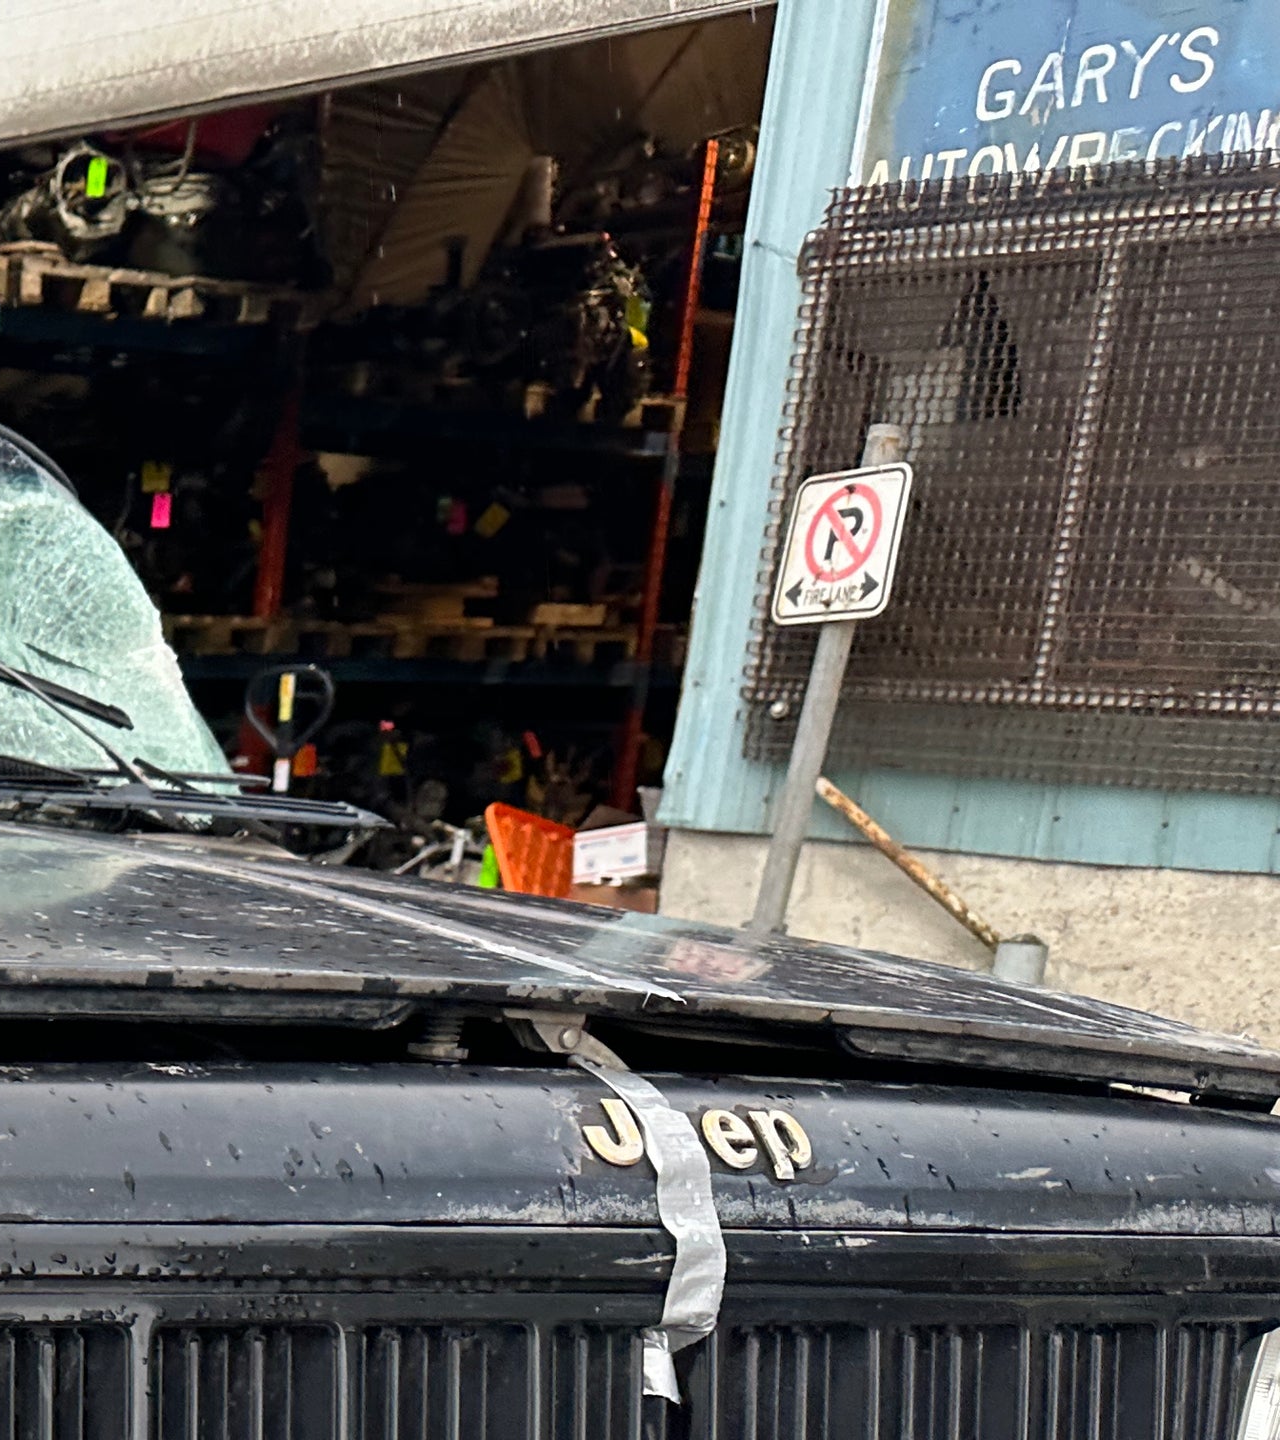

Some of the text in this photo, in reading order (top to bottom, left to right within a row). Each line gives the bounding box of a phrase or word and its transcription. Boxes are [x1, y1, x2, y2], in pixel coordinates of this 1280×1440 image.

[975, 26, 1220, 122] GARY'S
[803, 584, 858, 605] FIRE LANE
[582, 1098, 813, 1180] Jep
